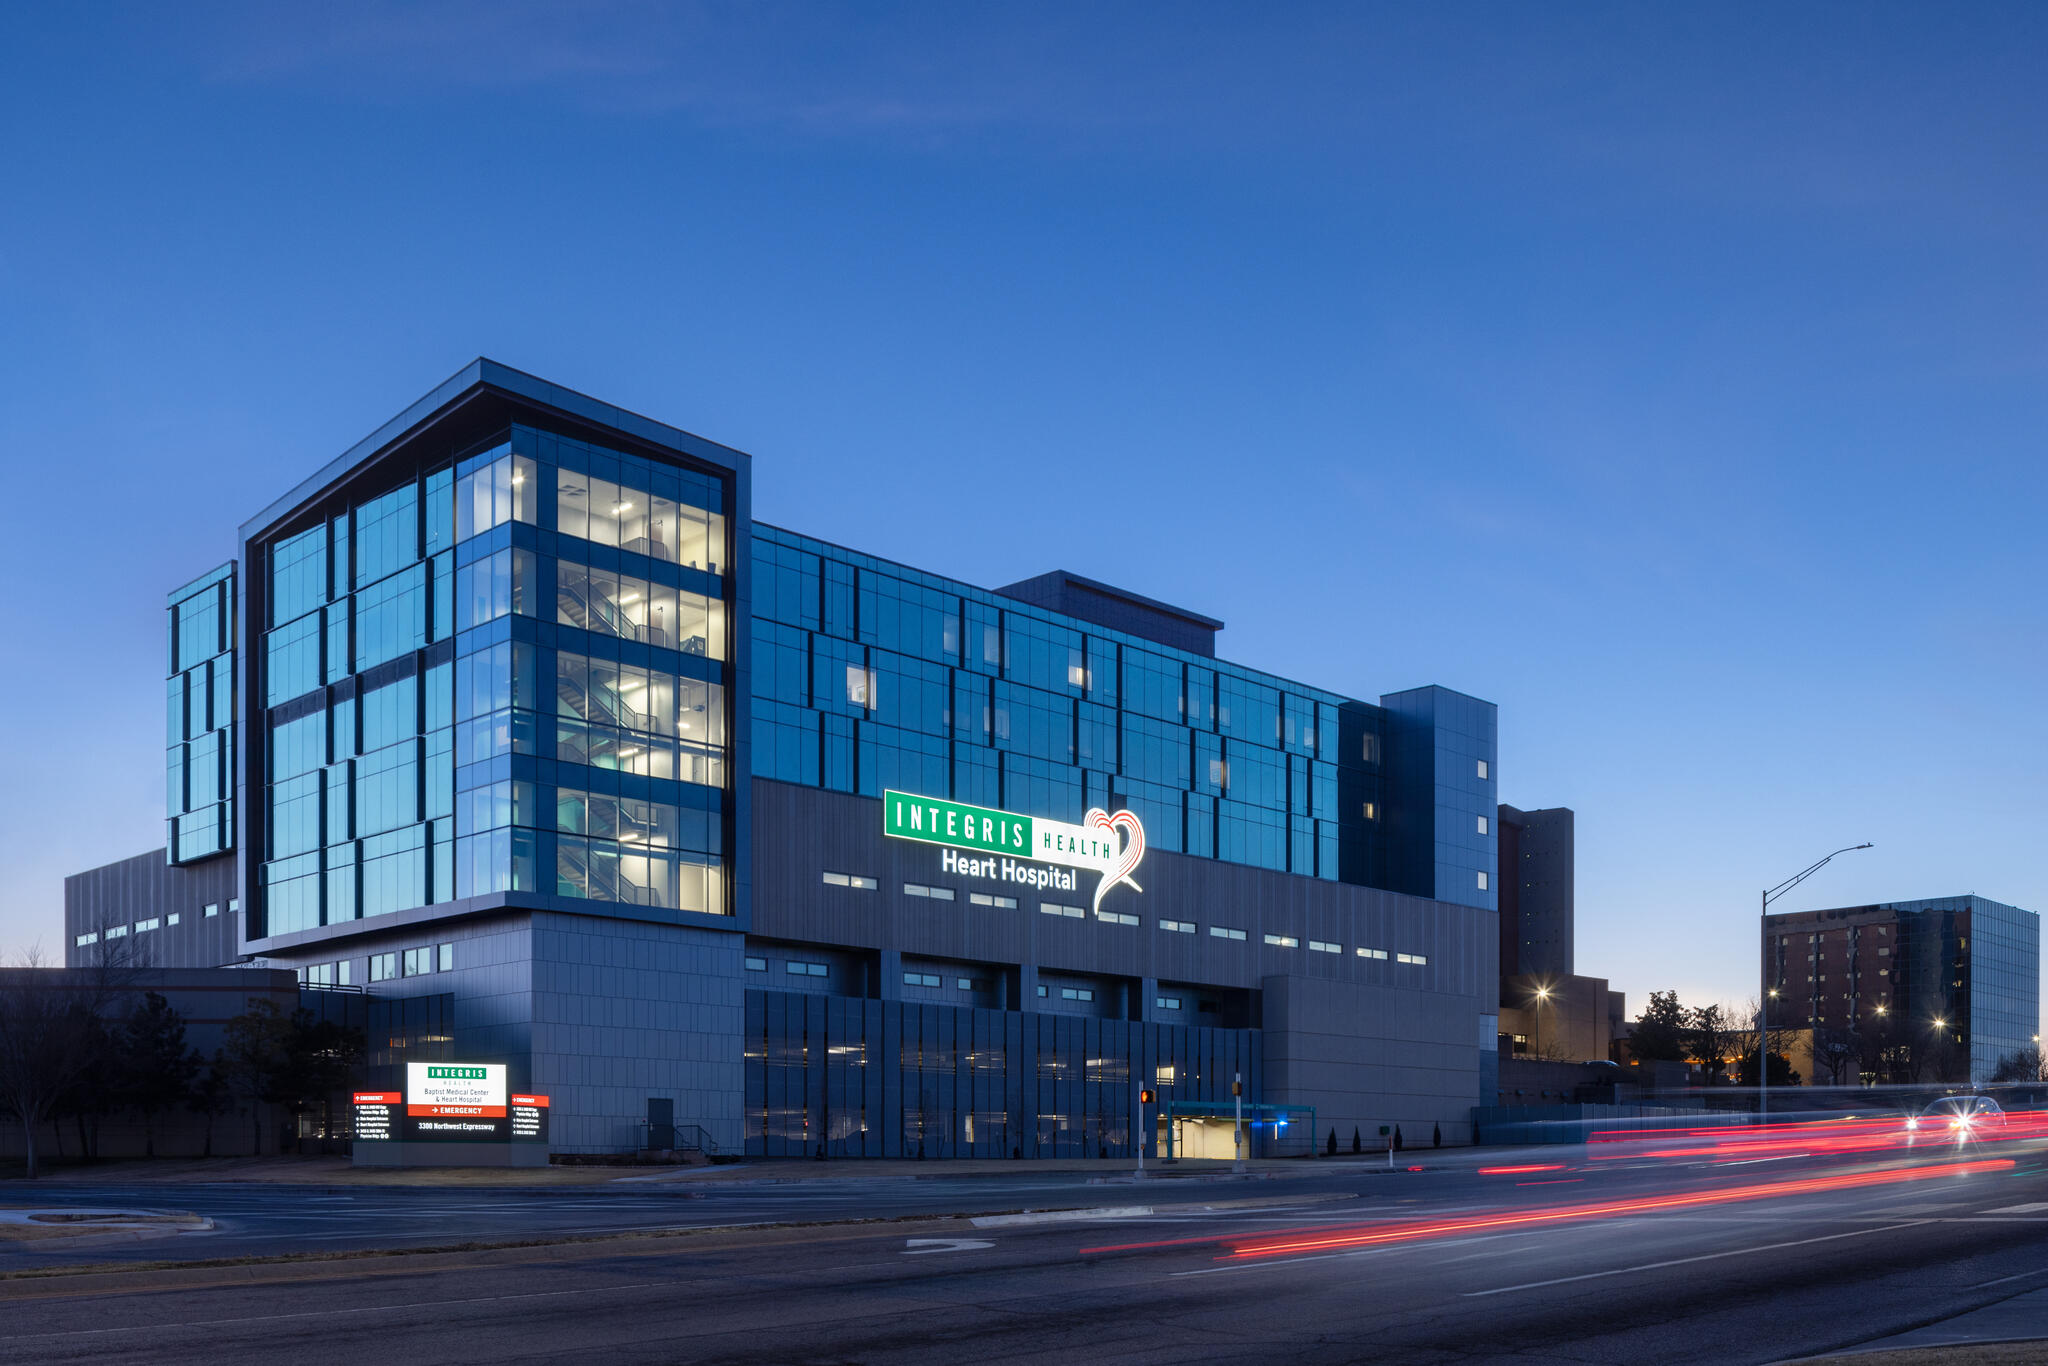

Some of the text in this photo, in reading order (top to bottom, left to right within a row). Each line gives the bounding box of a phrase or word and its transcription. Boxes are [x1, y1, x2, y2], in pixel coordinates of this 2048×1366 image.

[896, 801, 1110, 859] INTEGRIS HEALTH
[942, 849, 1076, 891] Heart Hospital
[431, 1068, 483, 1078] INTEGRIS
[424, 1088, 445, 1096] Baptist
[459, 1096, 482, 1104] Hospital
[418, 1122, 495, 1132] 3300 Northwest Expressway
